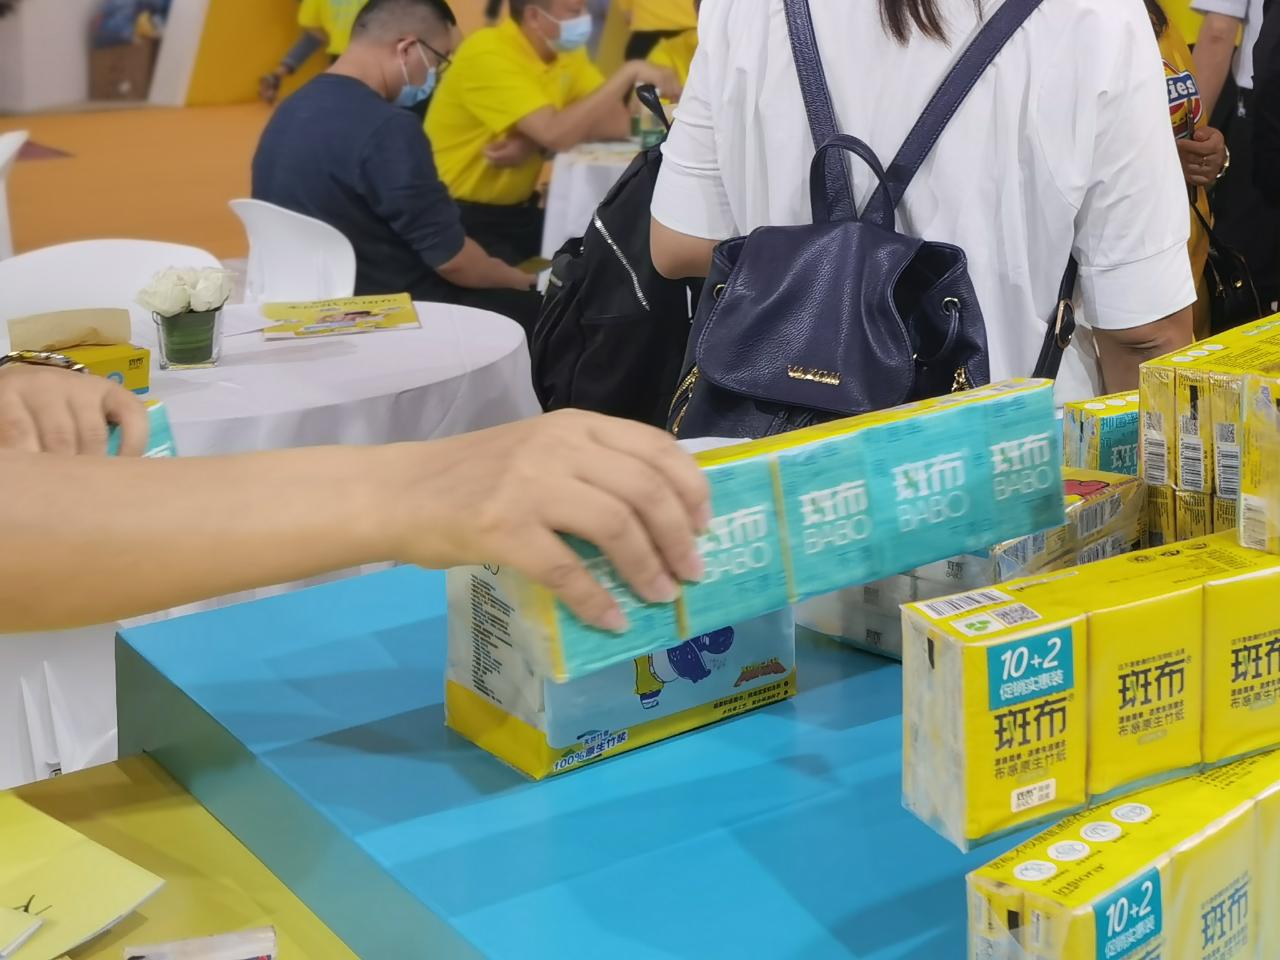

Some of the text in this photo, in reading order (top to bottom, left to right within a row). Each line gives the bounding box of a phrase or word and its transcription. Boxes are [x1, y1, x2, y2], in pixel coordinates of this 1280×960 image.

[1168, 80, 1196, 100] ies
[990, 431, 1051, 474] 斑布
[892, 451, 967, 501] 斑布
[993, 465, 1054, 502] BABO
[800, 480, 870, 526] 斑布
[899, 490, 971, 533] BABO
[999, 637, 1062, 681] 10+2
[1118, 658, 1185, 710] 斑布
[994, 693, 1067, 751] 斑布
[1105, 880, 1153, 937] 10+2
[1201, 880, 1249, 950] 斑布
